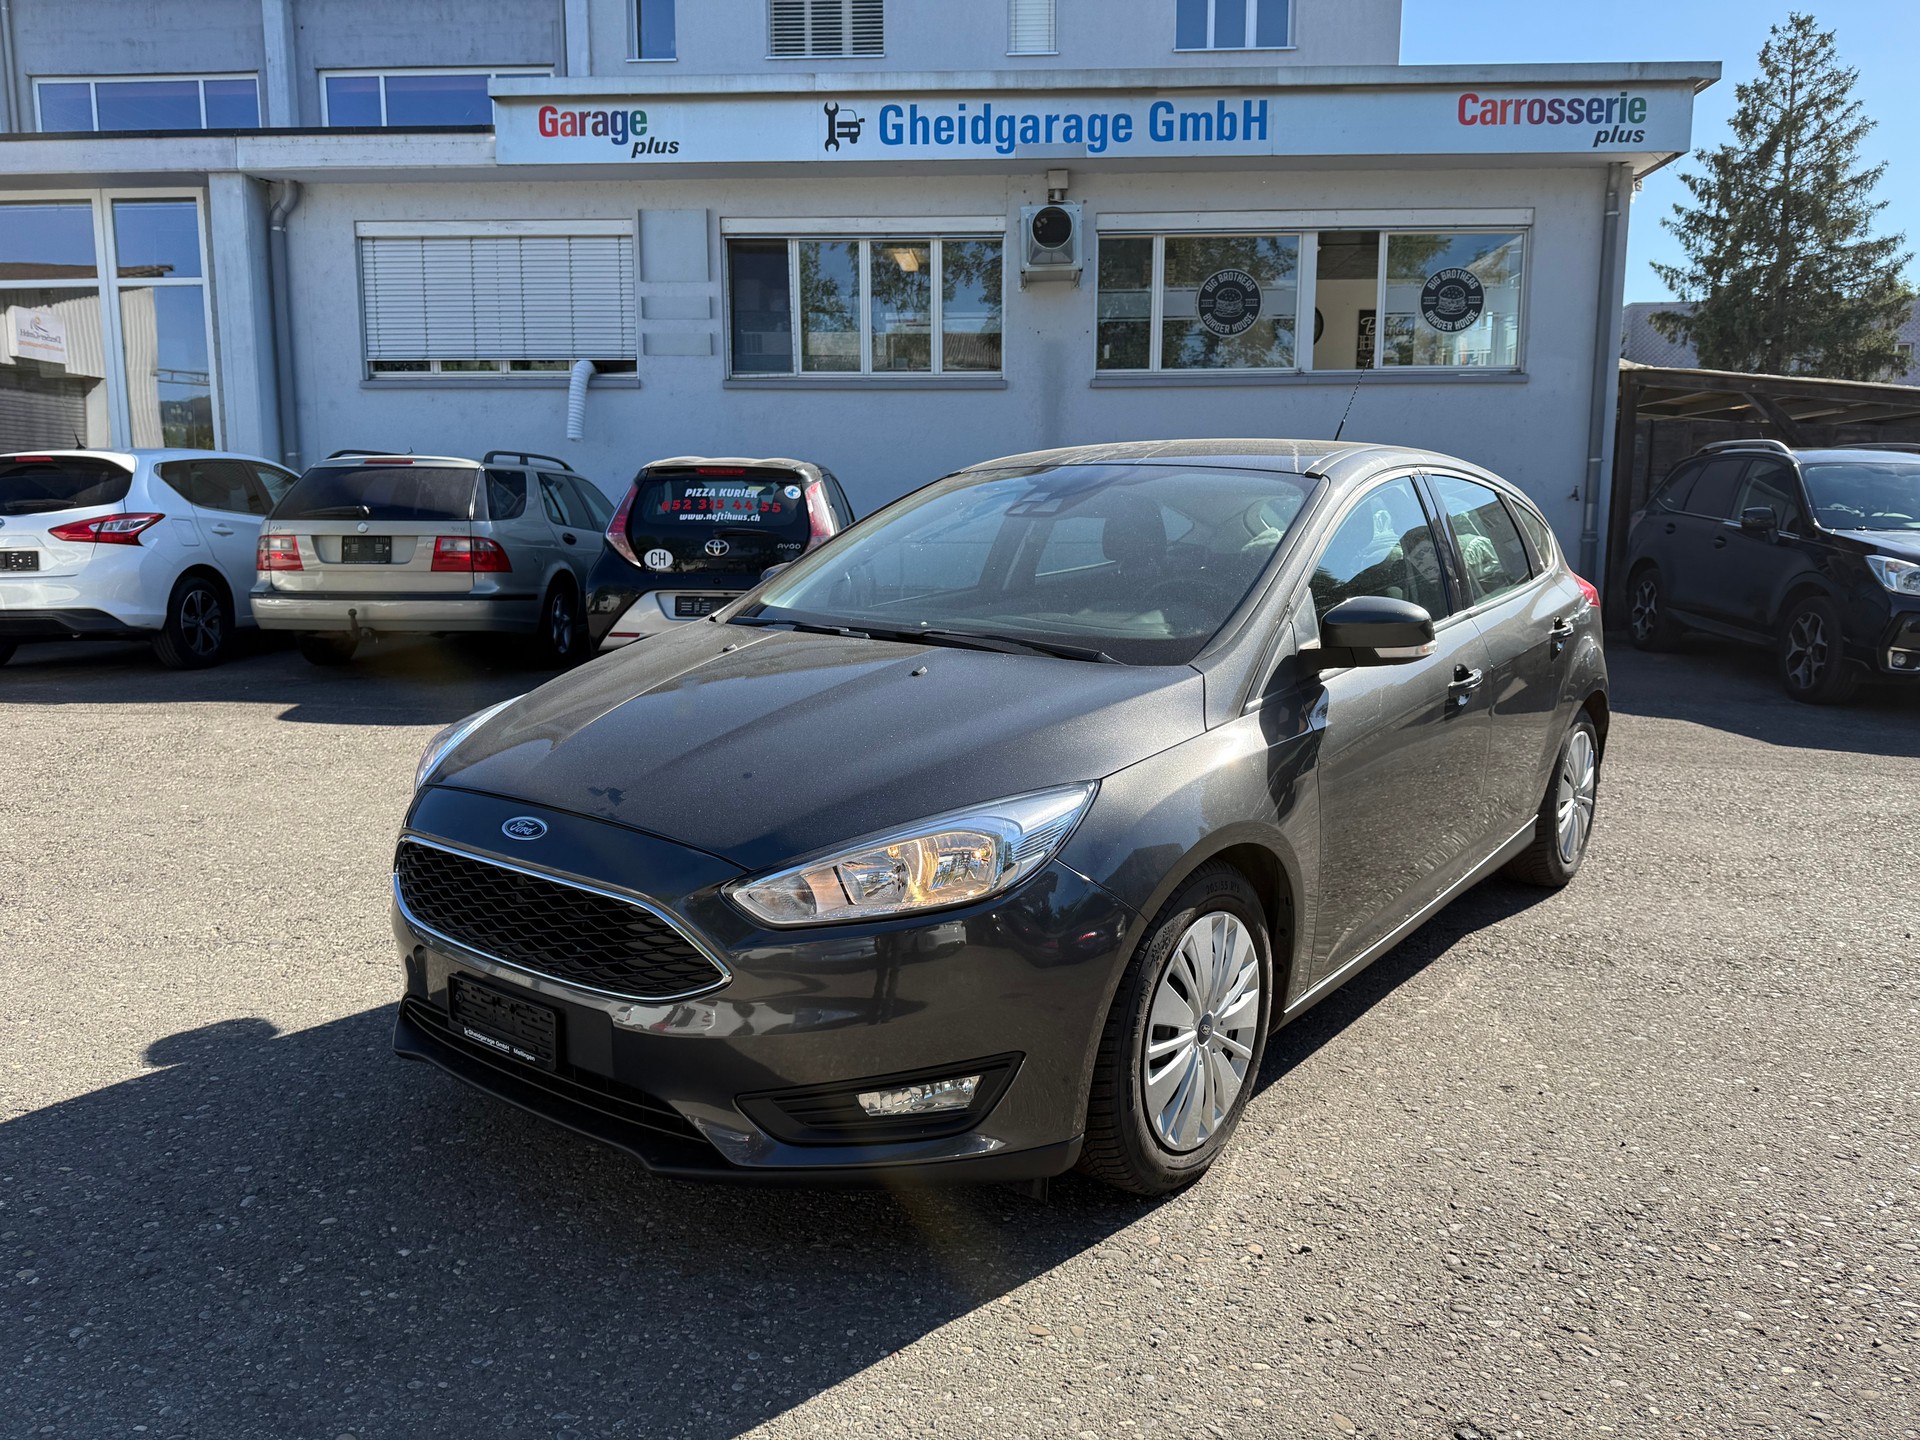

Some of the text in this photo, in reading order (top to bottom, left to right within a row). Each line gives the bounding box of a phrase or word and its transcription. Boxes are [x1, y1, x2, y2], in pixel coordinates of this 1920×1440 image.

[1458, 91, 1647, 126] Carrosserie
[538, 105, 648, 145] Garage
[879, 99, 1268, 154] Gheidgarage GmbH
[631, 136, 680, 158] plus
[1592, 125, 1645, 148] plus
[1204, 271, 1256, 293] BIG BROTHERS
[1427, 269, 1479, 290] BIG BROTHERS
[1202, 312, 1256, 334] BURGER HOUSE
[1425, 310, 1453, 331] BURGER
[1454, 309, 1479, 330] HOUSE
[685, 487, 759, 499] PIZZA KURIER
[661, 498, 781, 513] 052 315 44 55
[679, 511, 761, 522] www.neftihuus.ch
[650, 551, 667, 566] CH
[509, 820, 538, 835] Ford
